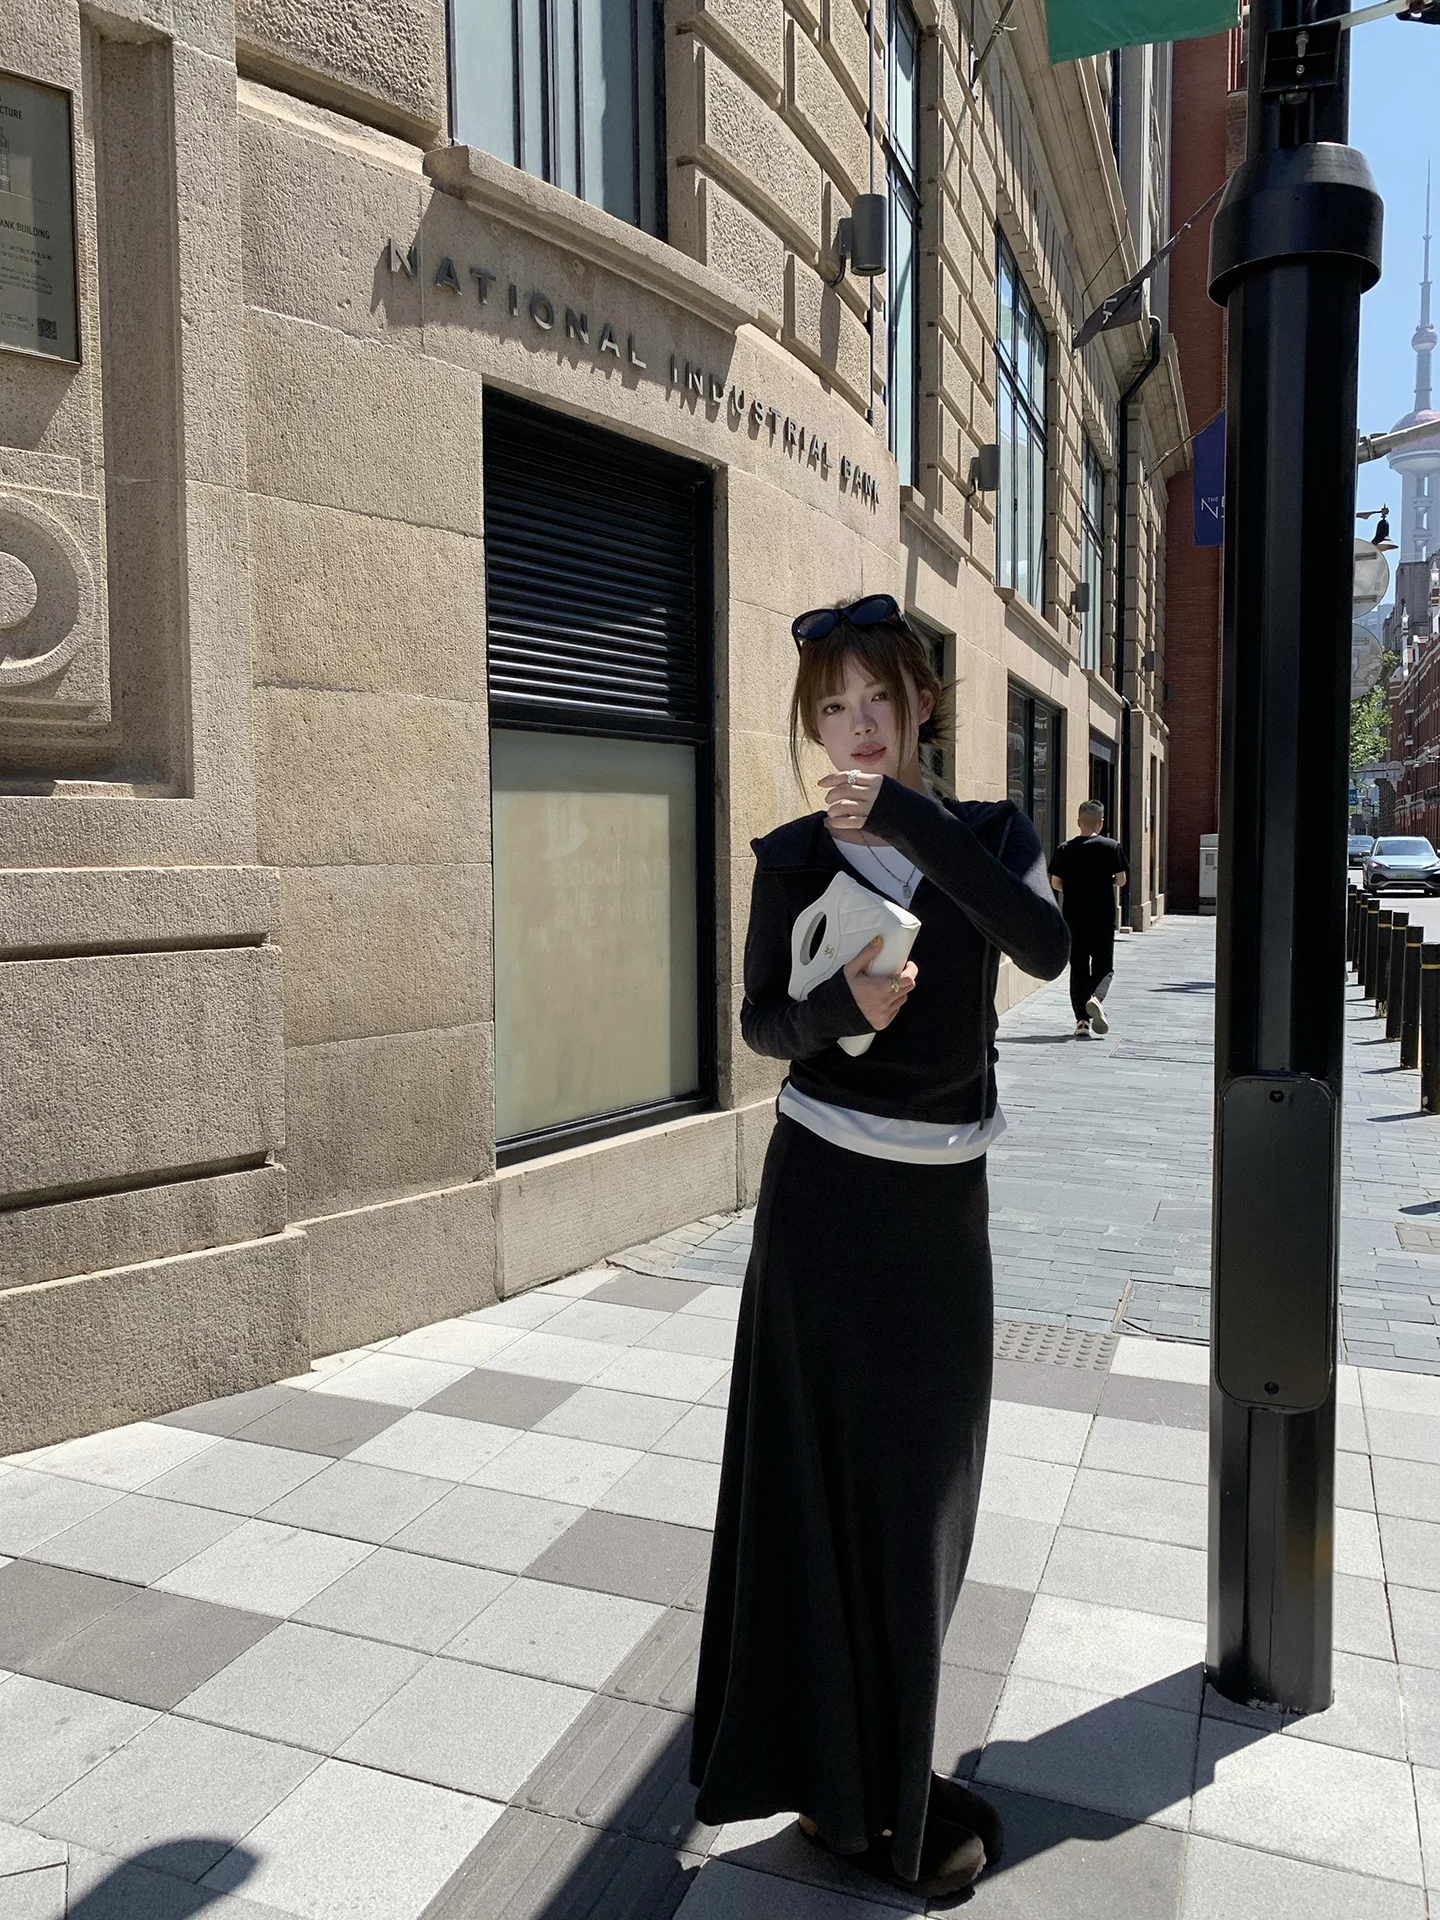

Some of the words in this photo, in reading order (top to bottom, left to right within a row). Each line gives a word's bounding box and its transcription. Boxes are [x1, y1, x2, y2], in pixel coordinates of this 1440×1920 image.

[17, 223, 51, 240] BUILDING
[388, 237, 647, 369] NATIONAL
[669, 353, 833, 469] INDUSTRIAL
[841, 455, 880, 504] BANK
